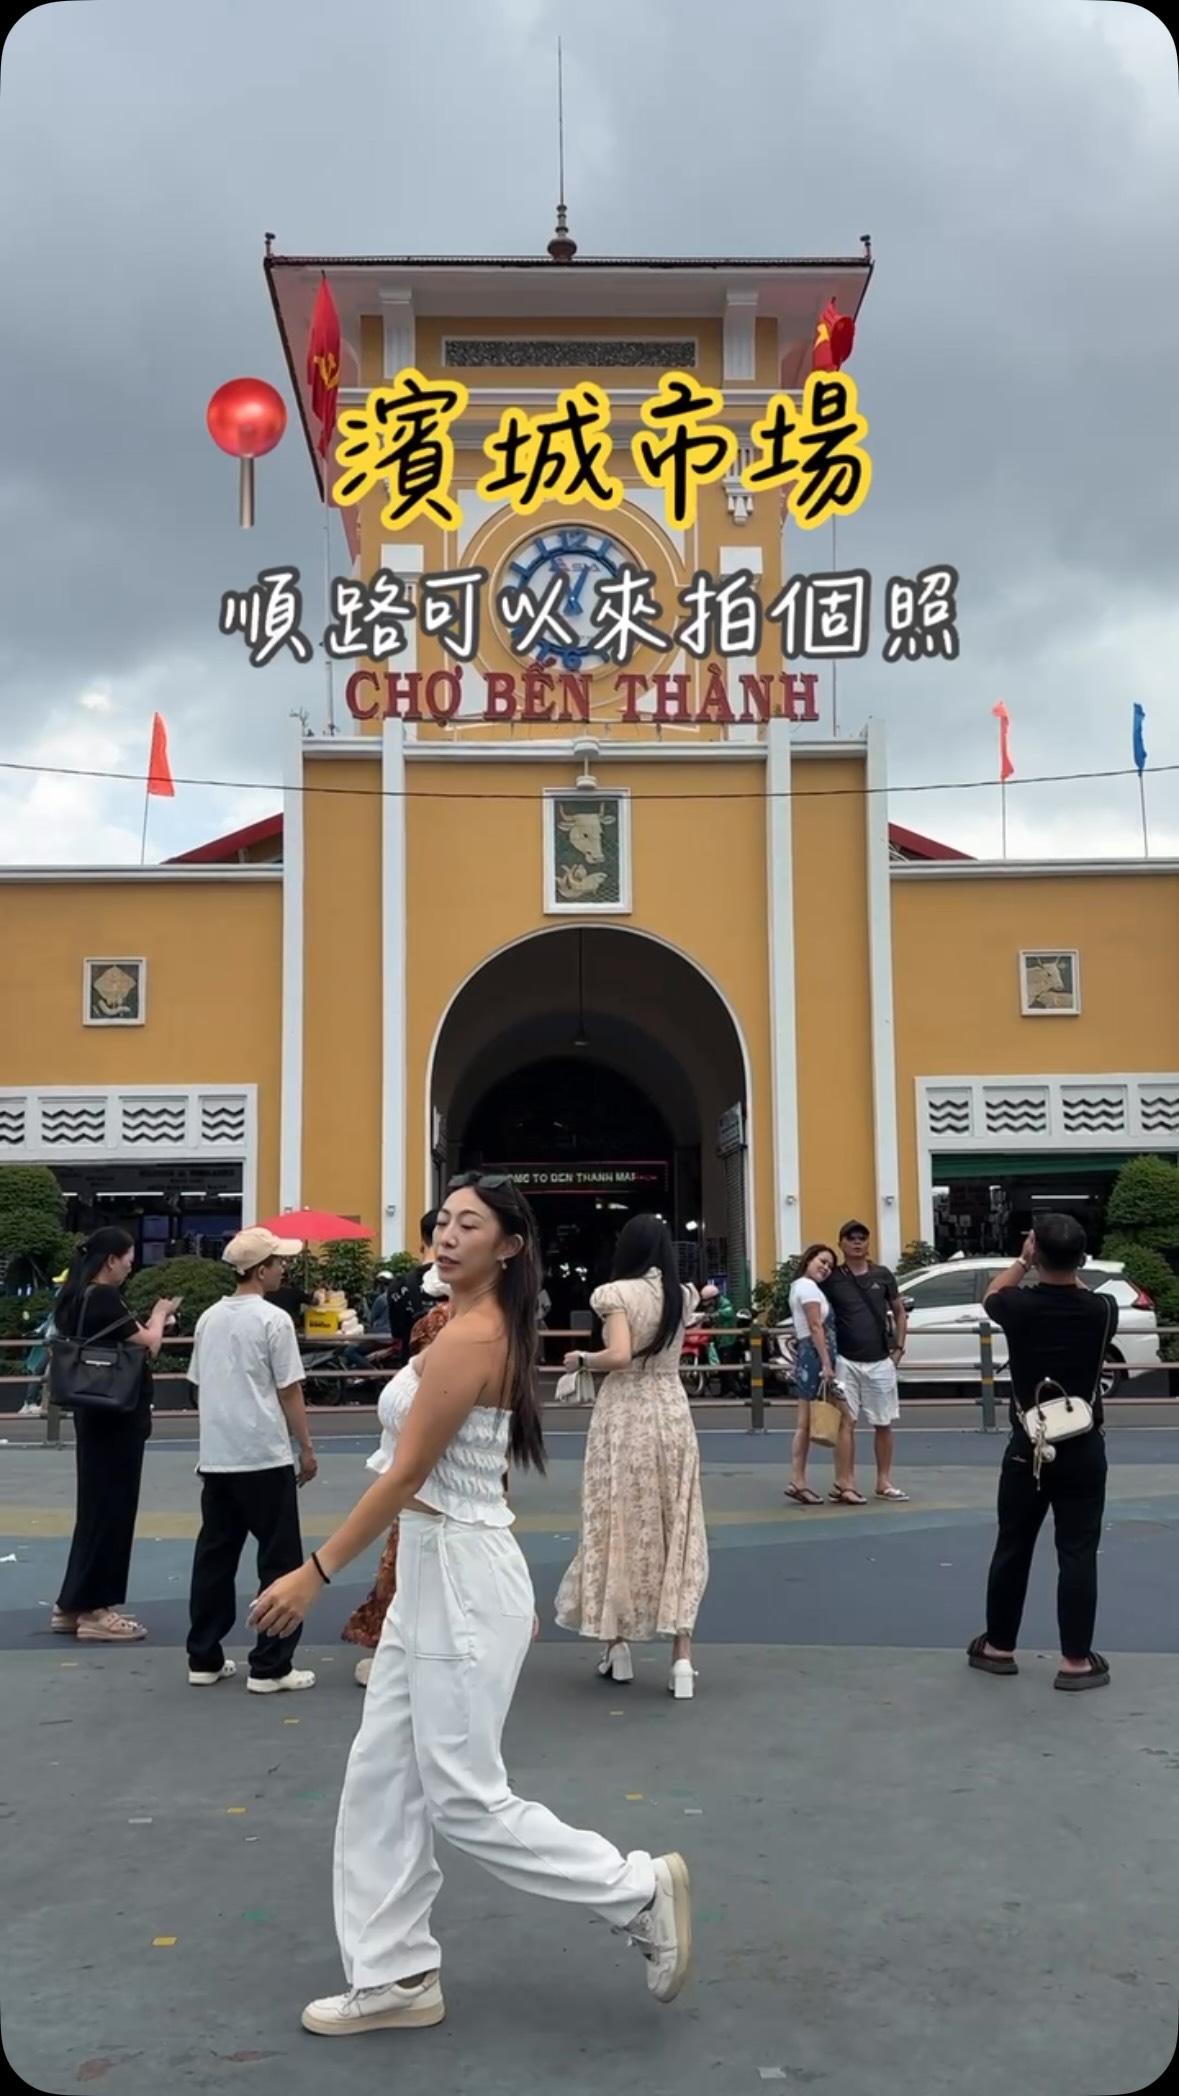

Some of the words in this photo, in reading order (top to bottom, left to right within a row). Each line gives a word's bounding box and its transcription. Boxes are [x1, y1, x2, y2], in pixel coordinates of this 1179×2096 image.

[345, 665, 464, 725] CHỢ
[483, 657, 592, 720] BẾN
[614, 662, 820, 721] THÀNH
[532, 1173, 548, 1183] TO
[576, 1172, 614, 1183] THANH
